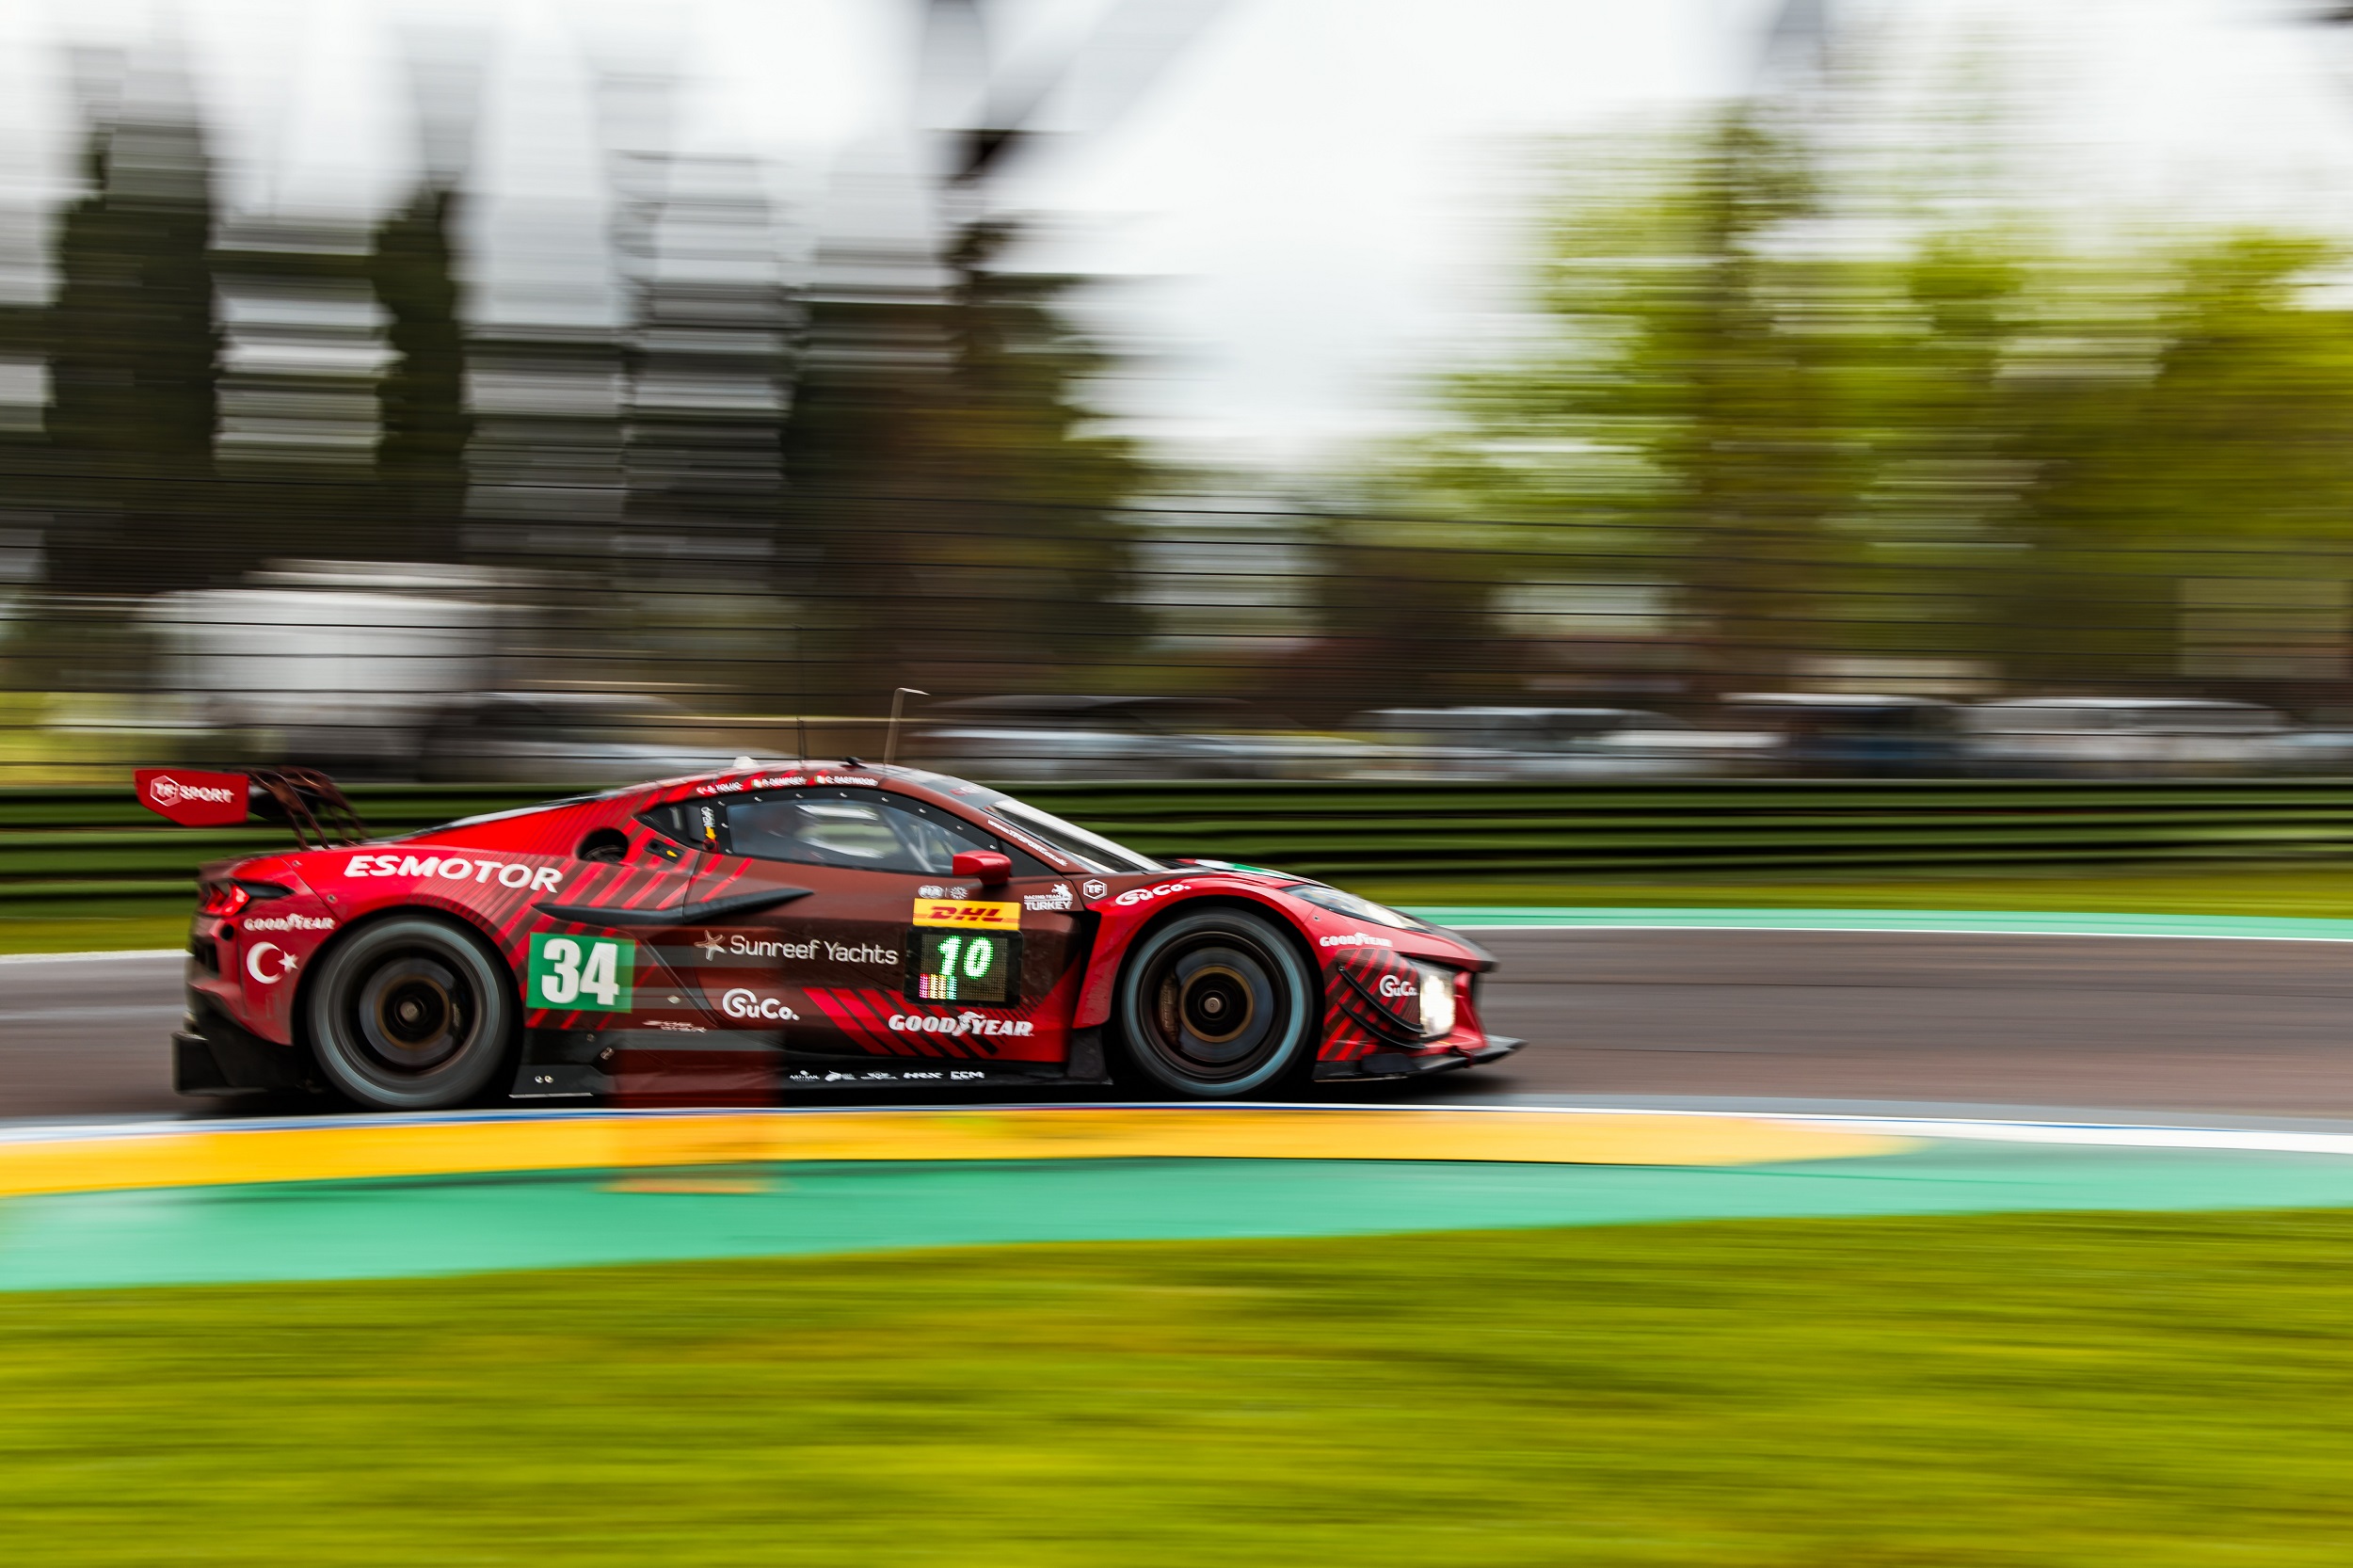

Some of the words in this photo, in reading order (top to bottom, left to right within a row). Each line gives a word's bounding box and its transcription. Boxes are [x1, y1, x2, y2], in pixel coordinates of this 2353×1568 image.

[179, 785, 234, 803] SPORT
[344, 855, 563, 893] ESMOTOR
[1085, 885, 1104, 893] TF
[928, 906, 1004, 922] DHL
[1023, 901, 1073, 910] TURKEY
[729, 935, 820, 960] Sunreef
[824, 939, 899, 965] Yachts
[937, 935, 994, 980] 10
[541, 937, 620, 1006] 34
